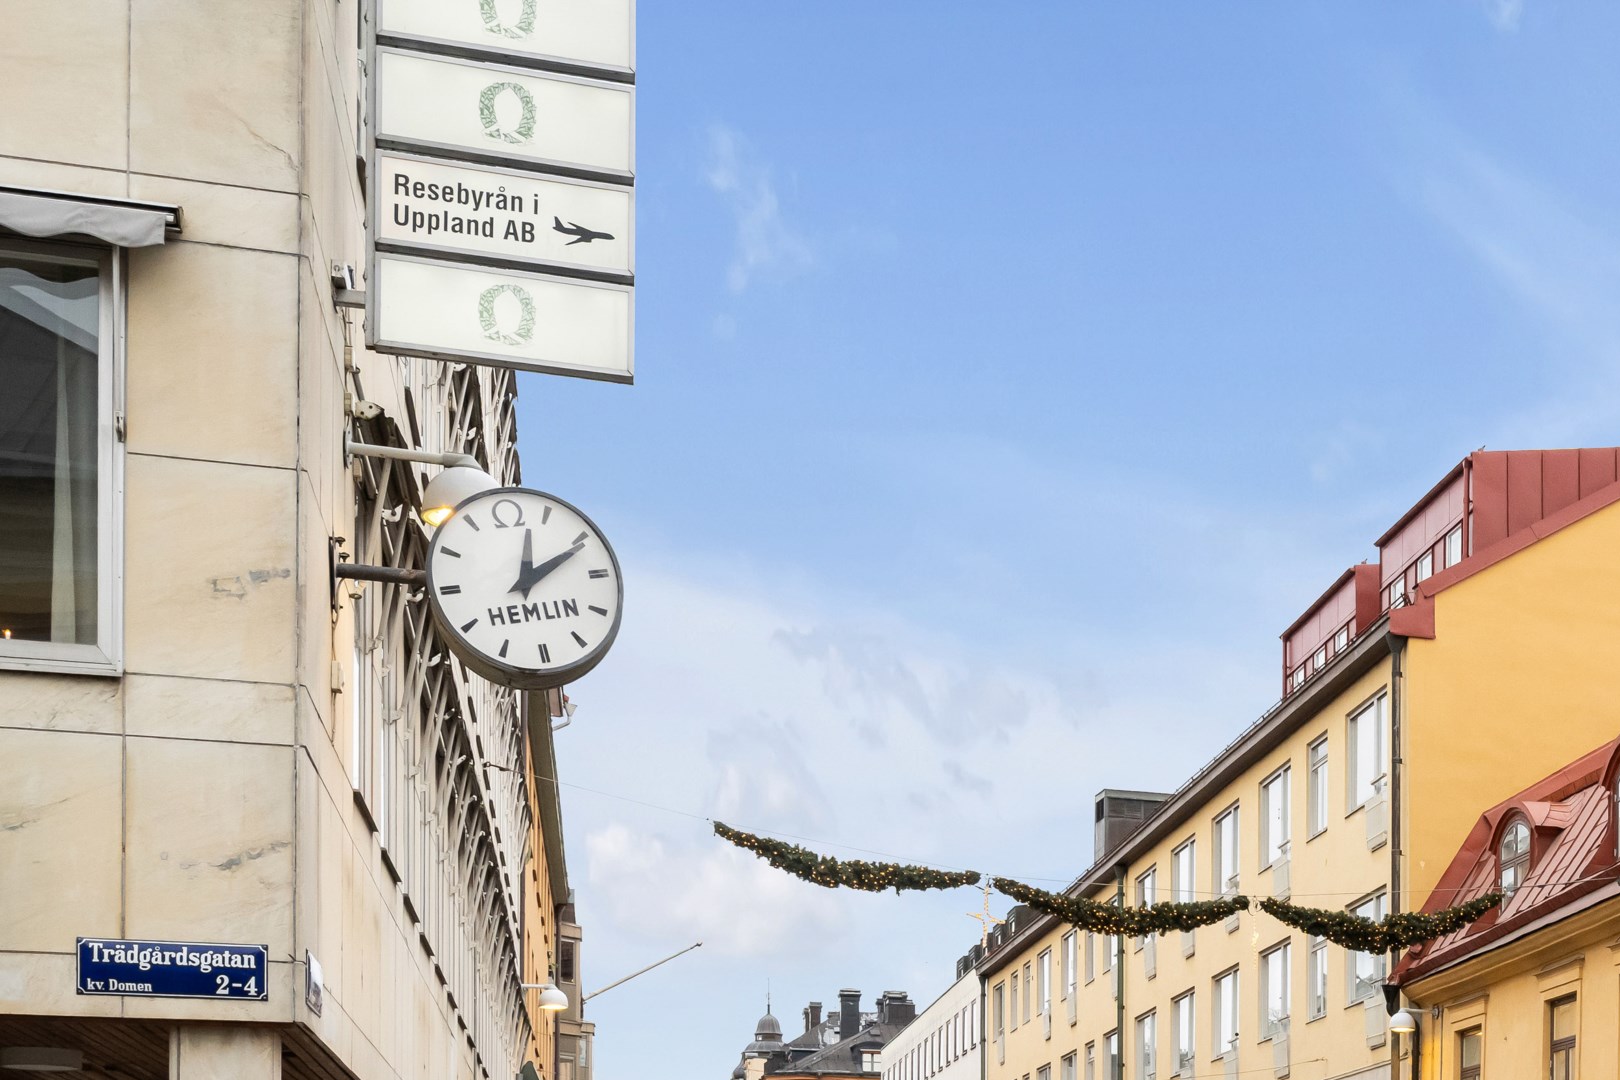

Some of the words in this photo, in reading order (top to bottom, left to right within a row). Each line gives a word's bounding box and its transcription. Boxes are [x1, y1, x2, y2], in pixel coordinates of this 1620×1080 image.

[394, 173, 523, 213] Resebyrån
[533, 193, 539, 215] i
[393, 203, 494, 239] Uppland
[504, 219, 536, 244] AB
[487, 598, 579, 626] HEMLIN
[88, 942, 256, 973] Trädgårdsgatan
[86, 978, 105, 991] kv.
[109, 978, 153, 992] Domen
[215, 974, 258, 996] 2-4
